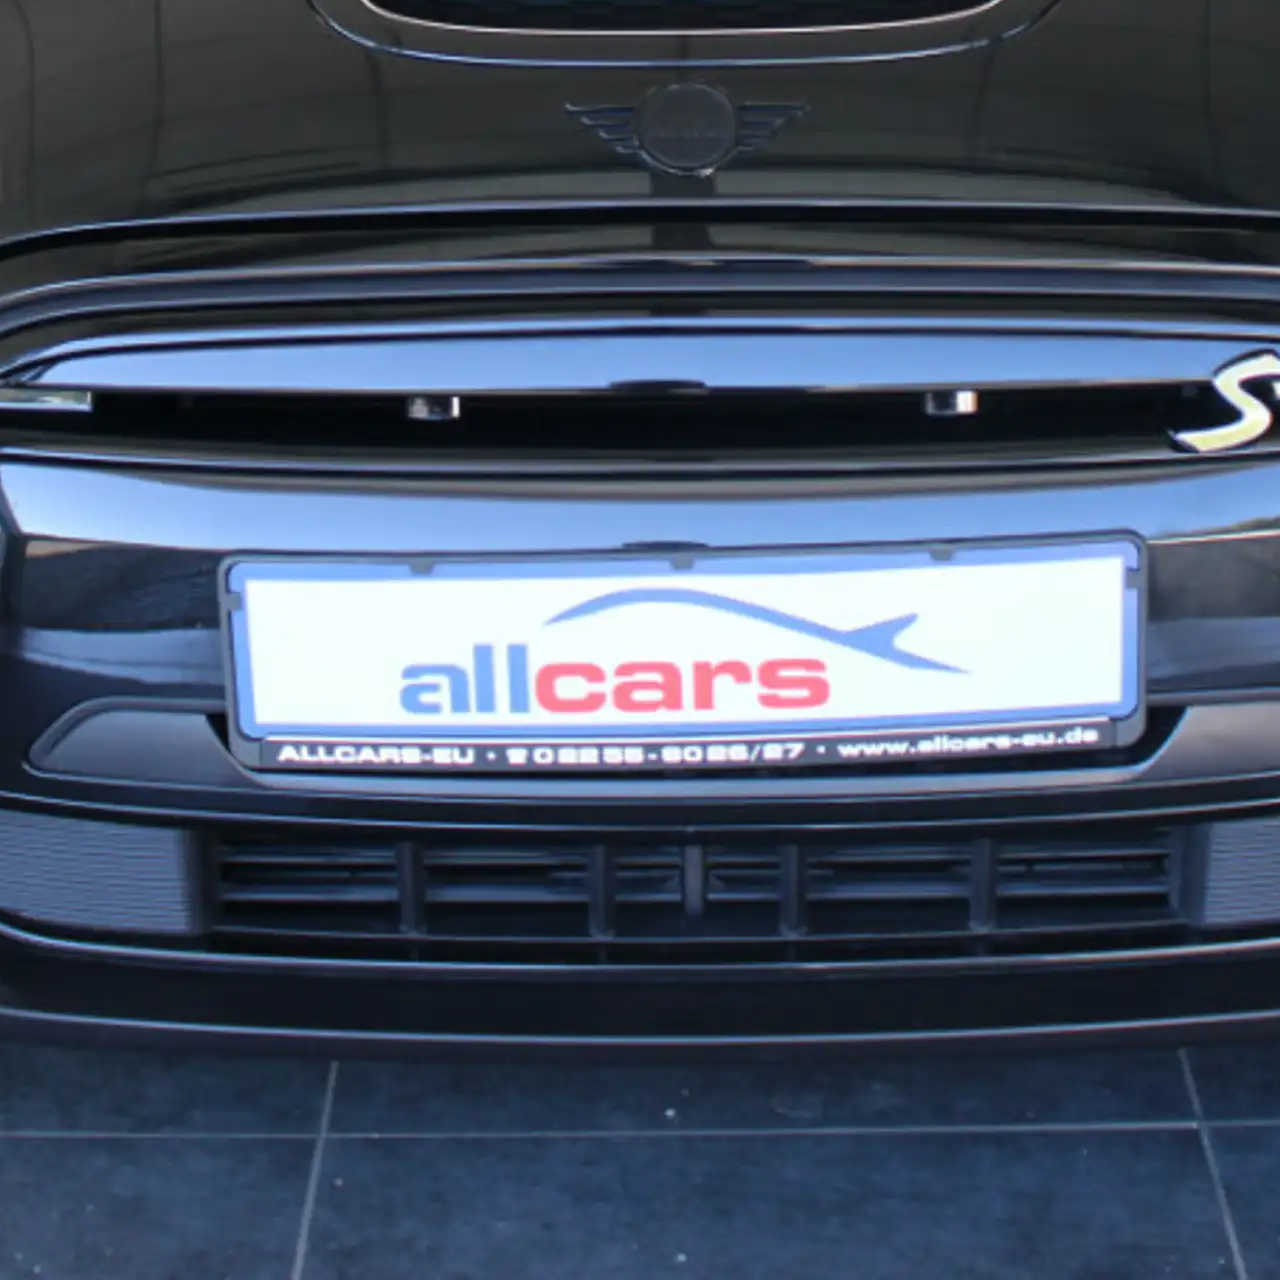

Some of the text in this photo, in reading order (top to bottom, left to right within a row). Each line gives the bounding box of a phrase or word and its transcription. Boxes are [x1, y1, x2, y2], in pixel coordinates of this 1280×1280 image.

[399, 643, 831, 715] allcars
[276, 744, 475, 765] ALLCARS-EU
[835, 725, 1100, 759] www.allcars-eu.de
